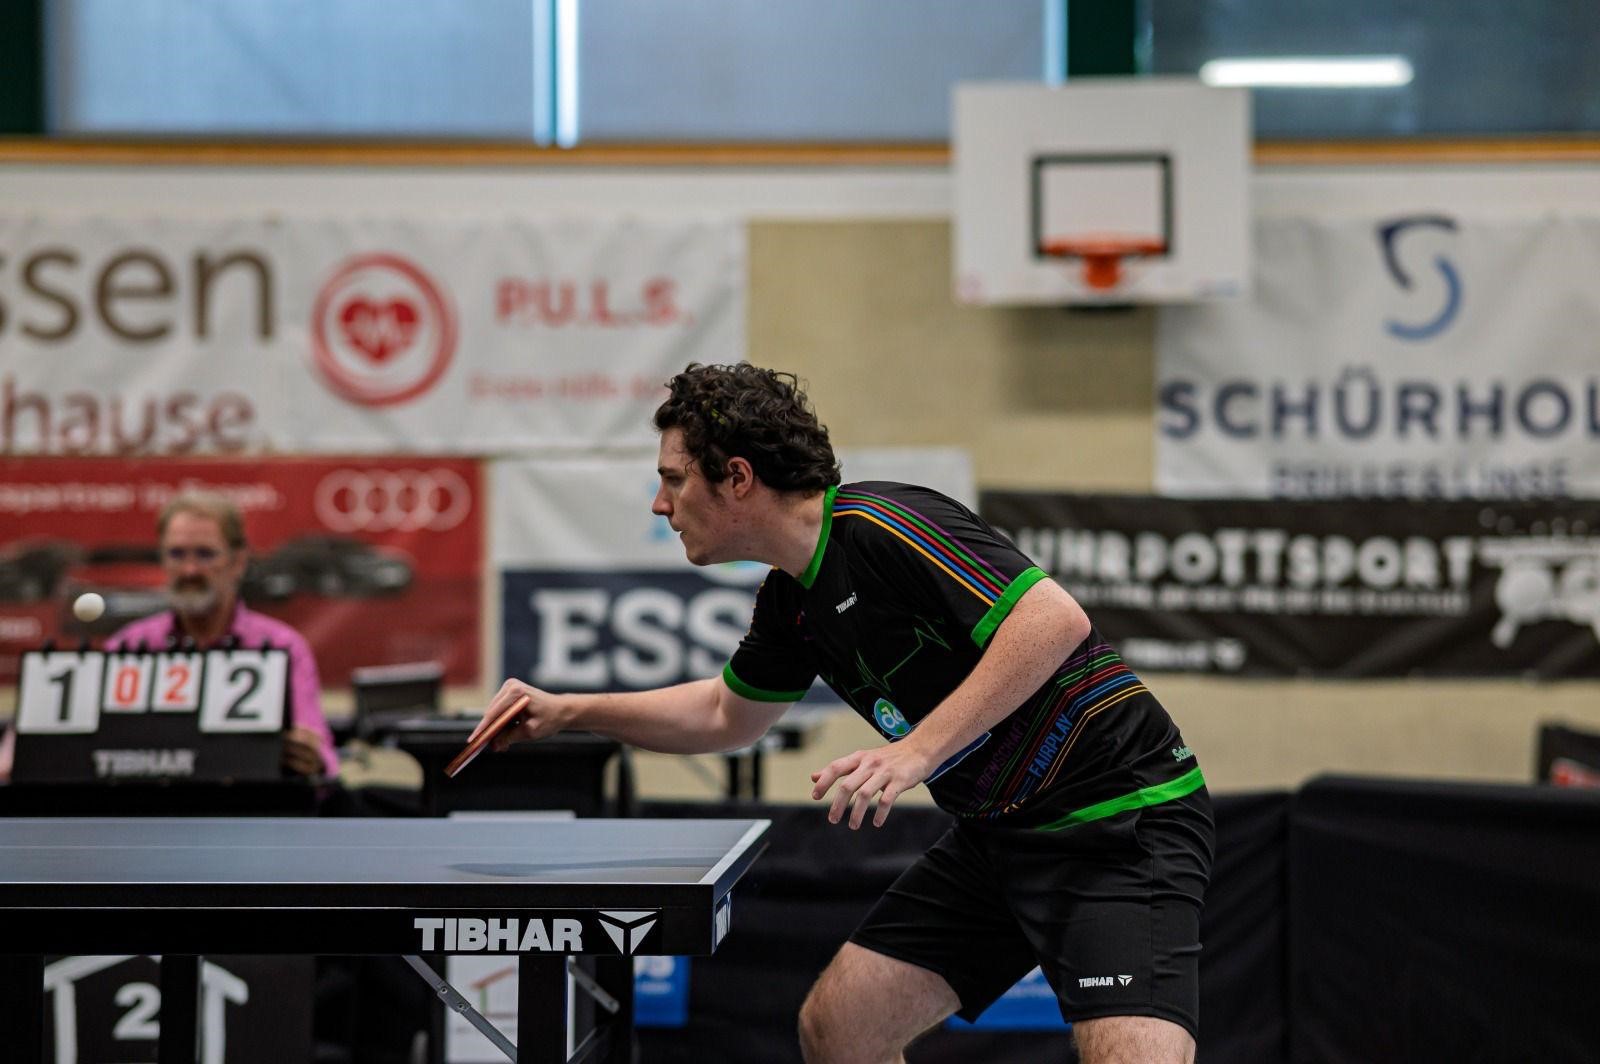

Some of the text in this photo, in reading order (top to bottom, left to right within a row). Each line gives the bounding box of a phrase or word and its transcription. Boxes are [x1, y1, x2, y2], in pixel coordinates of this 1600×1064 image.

[0, 247, 275, 343] sen
[996, 527, 1476, 591] UHRPOTTSPORT
[49, 663, 262, 722] 1 0 2 2
[1027, 713, 1073, 778] FAIRPLAY
[413, 917, 584, 952] TIBHAR
[112, 981, 162, 1040] 2
[1078, 976, 1114, 989] TIBHAR
